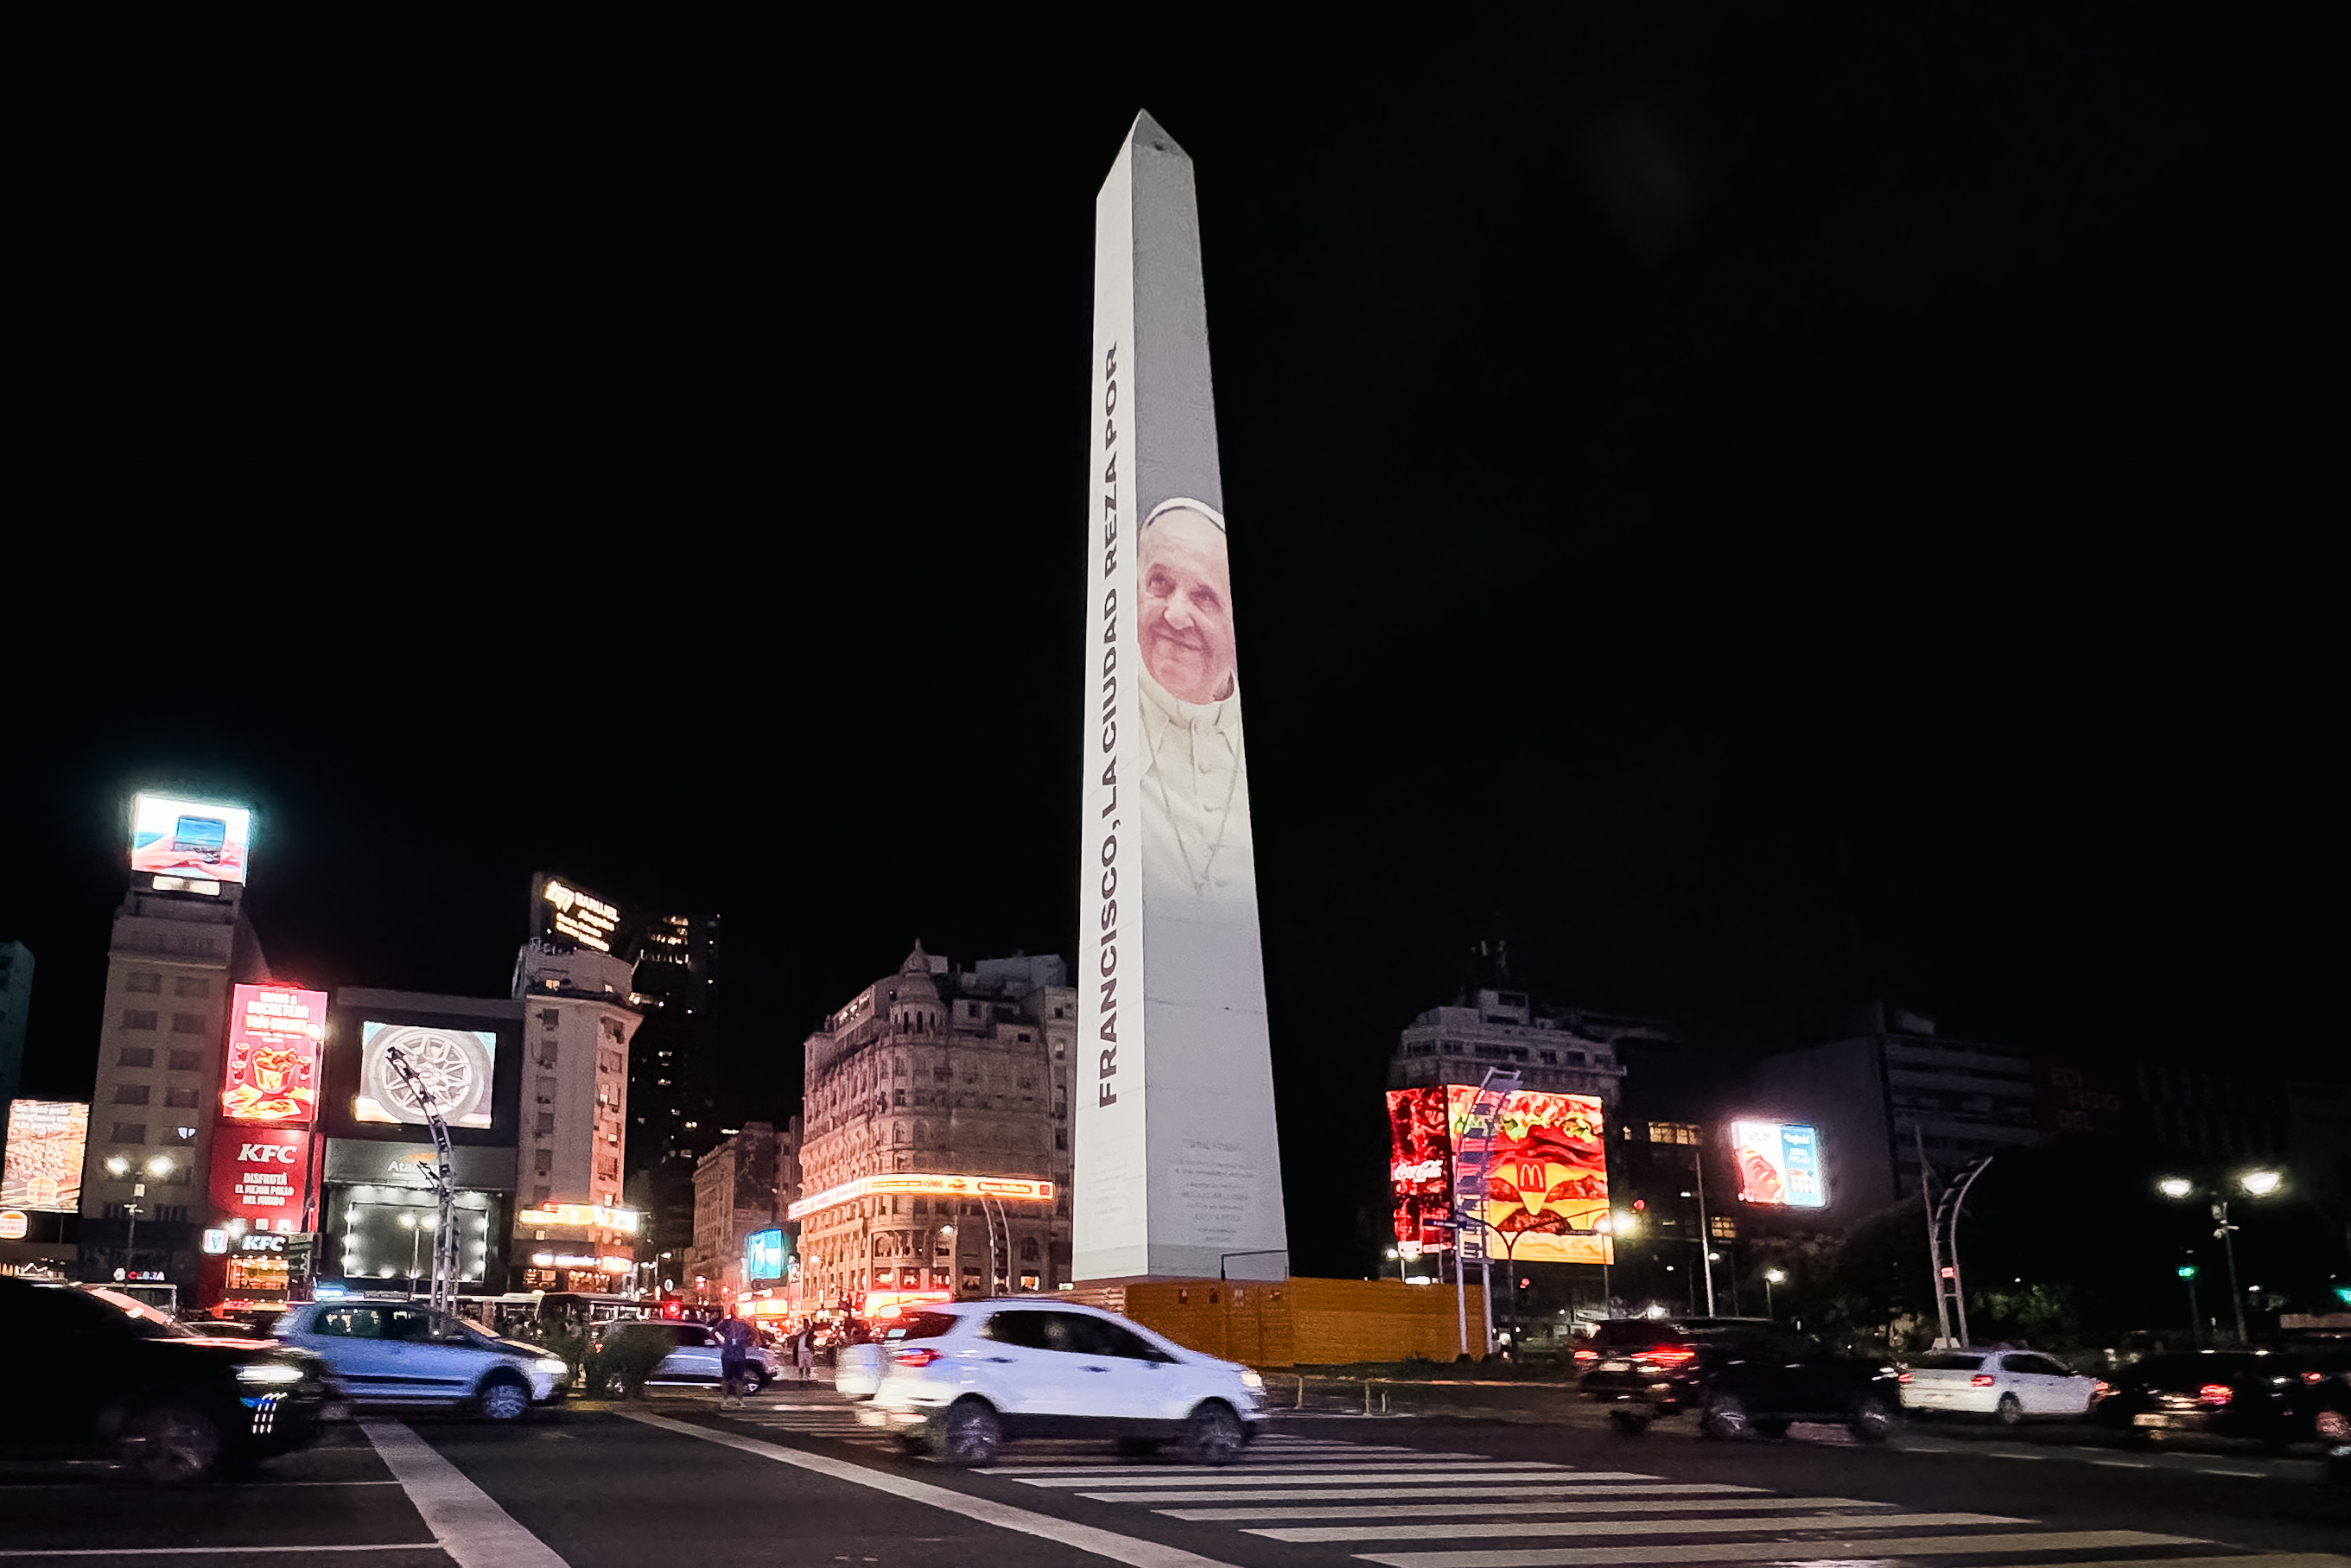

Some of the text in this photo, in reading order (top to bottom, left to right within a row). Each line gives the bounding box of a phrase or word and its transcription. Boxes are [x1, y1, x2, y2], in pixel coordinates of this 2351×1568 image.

[1099, 340, 1121, 1108] FRANCISCO, LA CIUDAD REZA POR
[575, 892, 620, 922] BARUJEL
[237, 1143, 297, 1164] KFC
[243, 1171, 287, 1186] DISFRUTÁ
[242, 1235, 286, 1252] KFC
